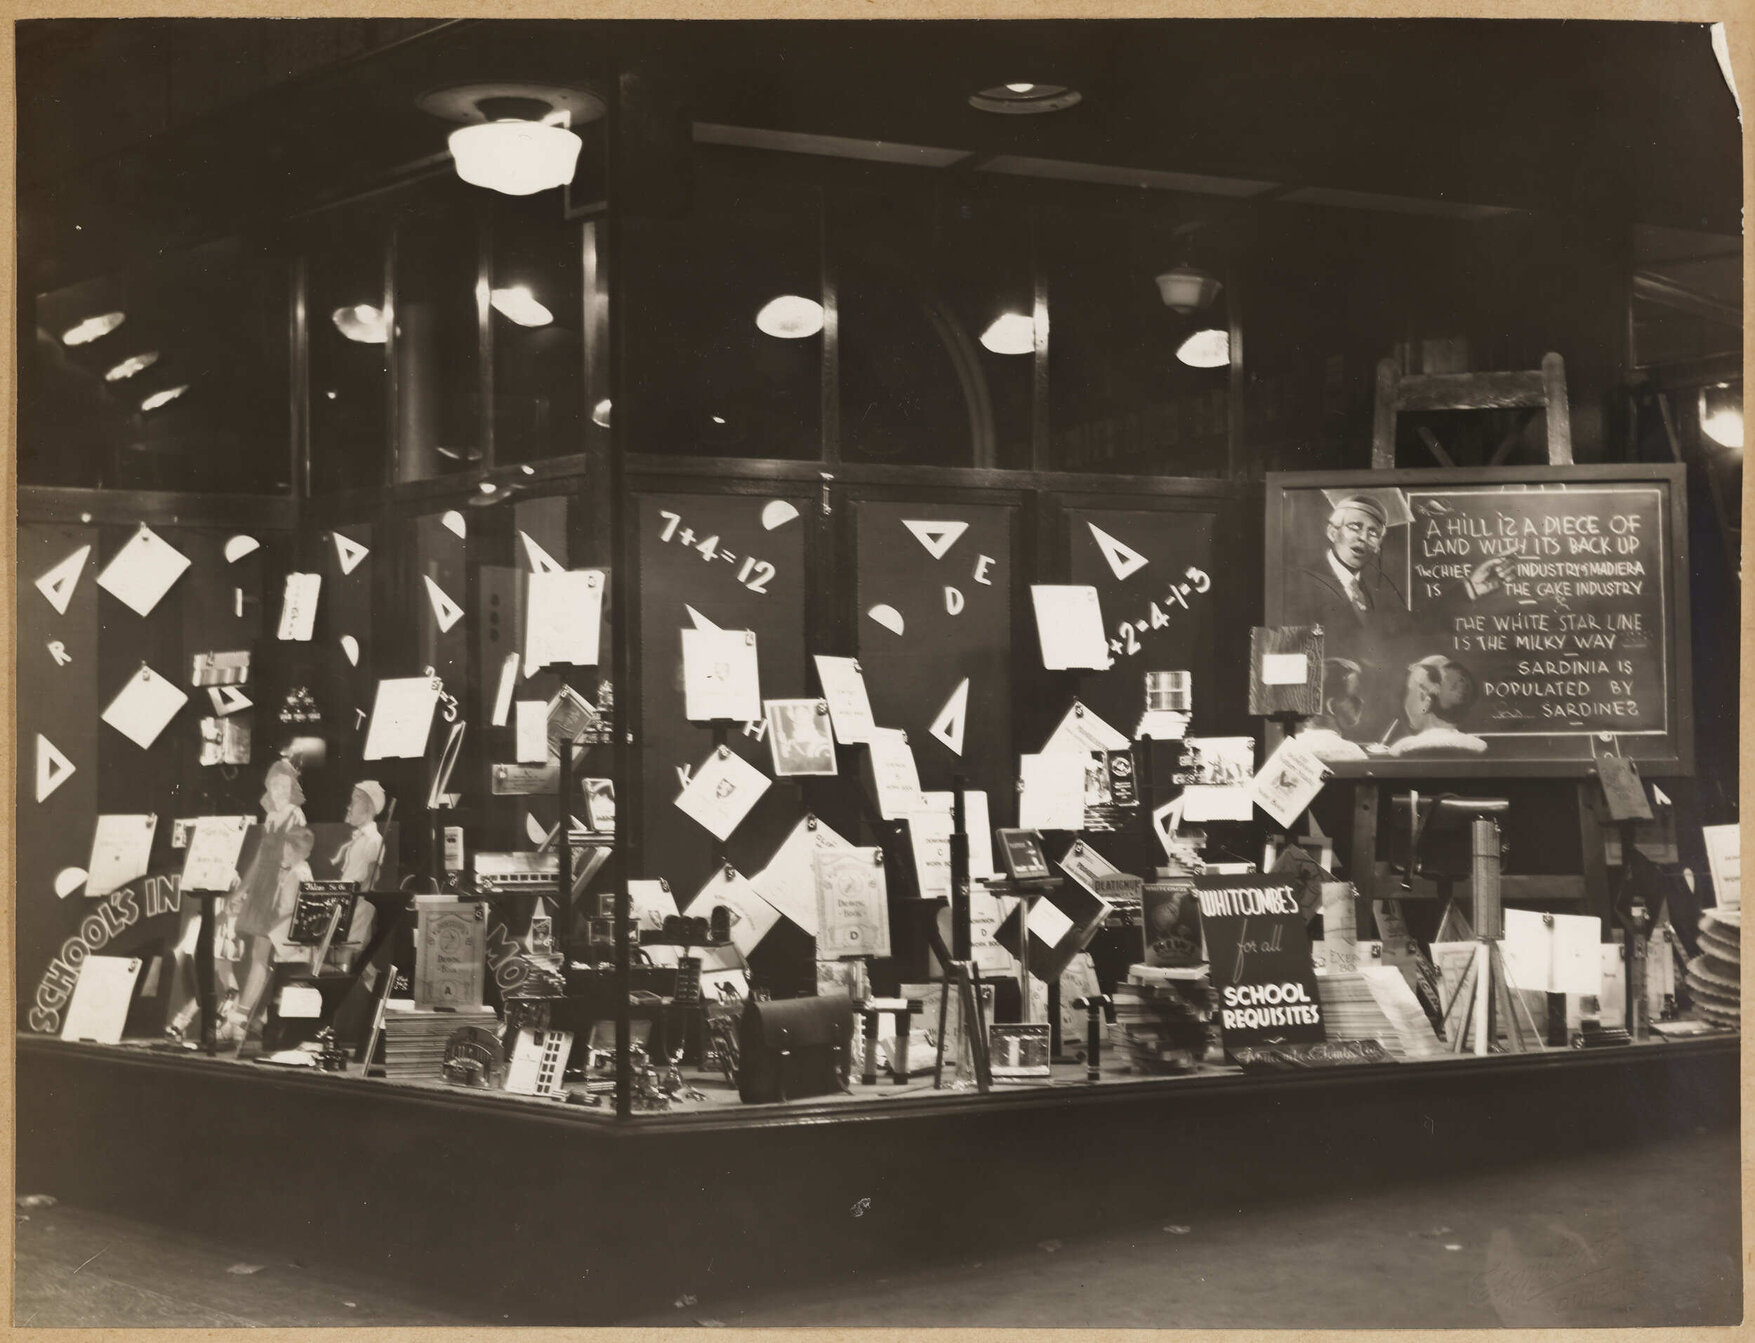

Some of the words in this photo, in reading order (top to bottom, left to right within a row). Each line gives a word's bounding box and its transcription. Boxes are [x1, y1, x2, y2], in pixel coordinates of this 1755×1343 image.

[1427, 518, 1441, 539] A
[1448, 514, 1493, 537] HILL
[1524, 517, 1538, 536] A
[1545, 515, 1600, 536] PIECE
[1609, 515, 1641, 534] OF
[1424, 538, 1470, 558] LAND
[1479, 537, 1526, 554] WITH
[1535, 538, 1560, 554] ITS
[1569, 537, 1612, 555] BACK
[1617, 536, 1640, 555] UP
[1431, 564, 1472, 579] CHIEF
[1517, 563, 1581, 577] INDUSTRY
[1589, 562, 1645, 575] MADIERA
[1426, 584, 1441, 597] IS
[1504, 583, 1531, 597] THE
[1536, 582, 1571, 597] CAKE
[1576, 581, 1643, 596] INDUSTRY
[1455, 616, 1485, 631] THE
[1493, 614, 1550, 631] WHITE
[1559, 613, 1601, 631] STAR
[1607, 614, 1642, 631] LINE
[1454, 636, 1471, 650] IS
[1476, 635, 1508, 651] THE
[1516, 634, 1566, 651] MILKY
[1574, 634, 1617, 650] WAY
[1517, 660, 1610, 675] SARDINIA
[1618, 660, 1633, 675] IS
[1484, 681, 1590, 697] POPULATED
[1609, 680, 1634, 696] BY
[1542, 700, 1640, 719] SARDINES
[145, 873, 182, 917] IN
[1232, 918, 1257, 985] for
[1260, 924, 1283, 952] all
[1222, 983, 1312, 1008] SCHOOL
[1221, 1004, 1320, 1030] REQUISITES
